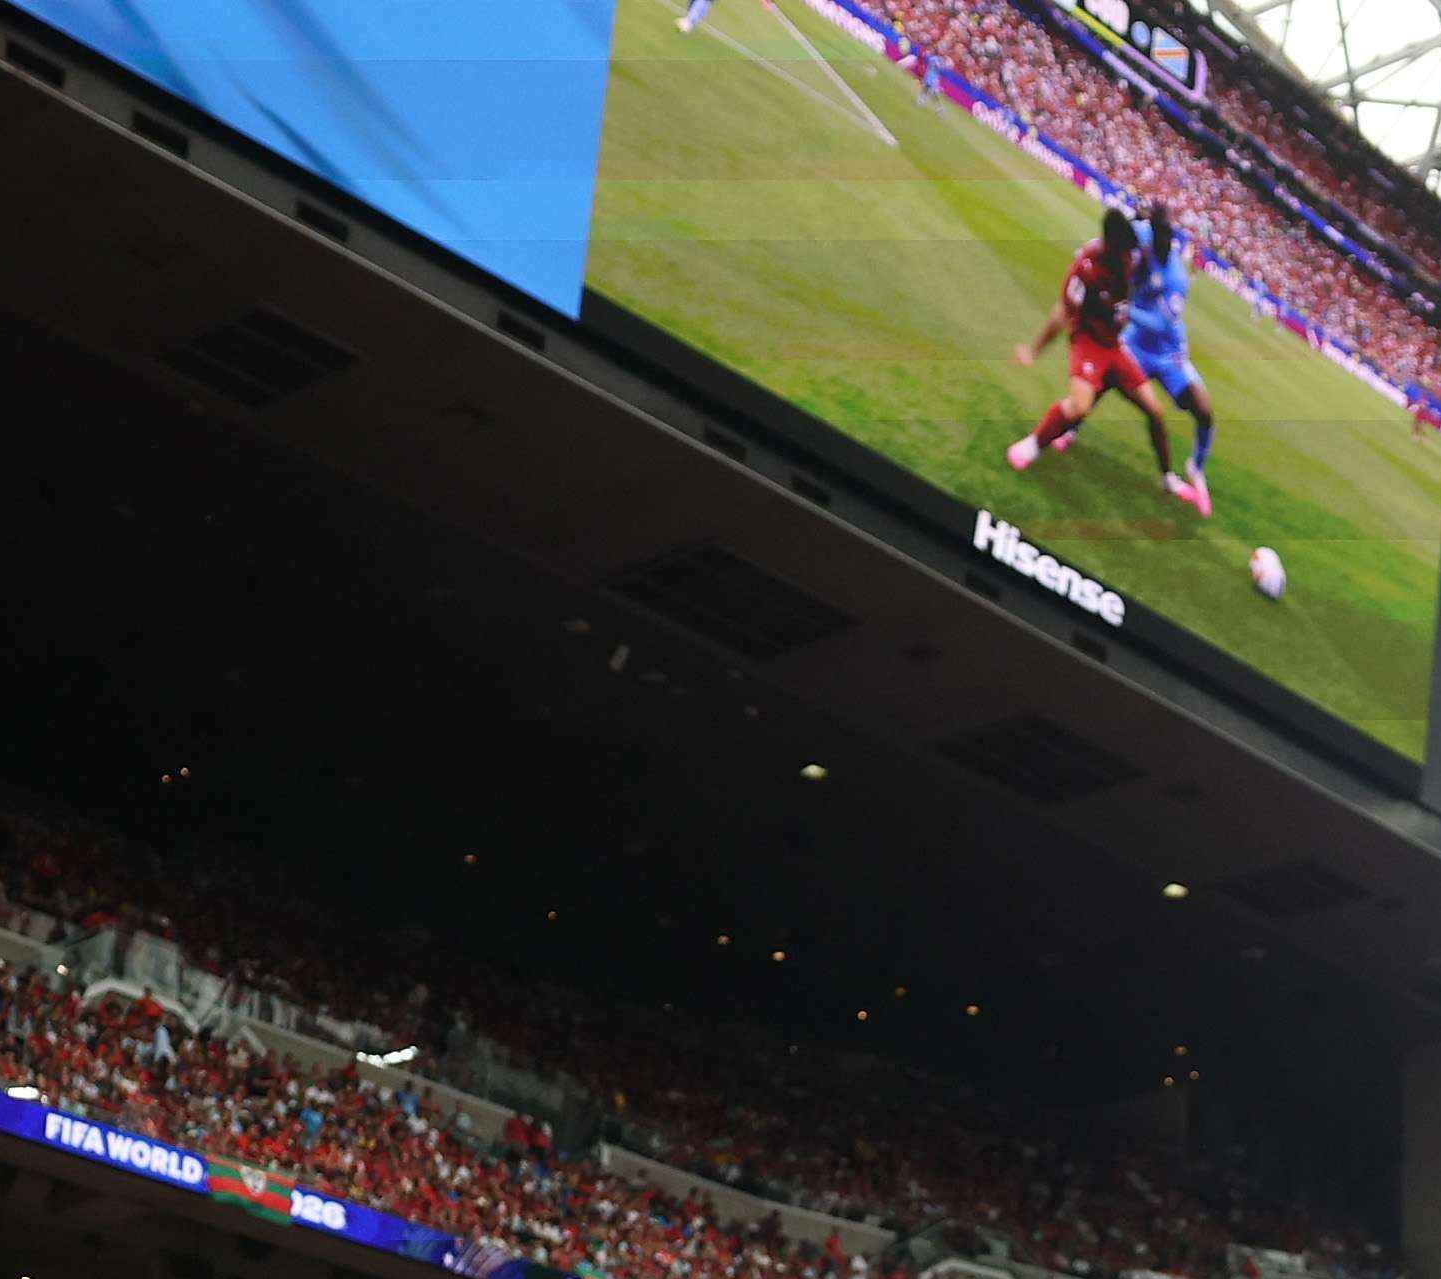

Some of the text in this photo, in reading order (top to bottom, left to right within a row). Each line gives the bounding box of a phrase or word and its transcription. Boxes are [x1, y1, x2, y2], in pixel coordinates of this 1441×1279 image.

[973, 509, 1125, 627] Hisense
[45, 1112, 105, 1157] FIFA
[107, 1131, 204, 1184] WORLD
